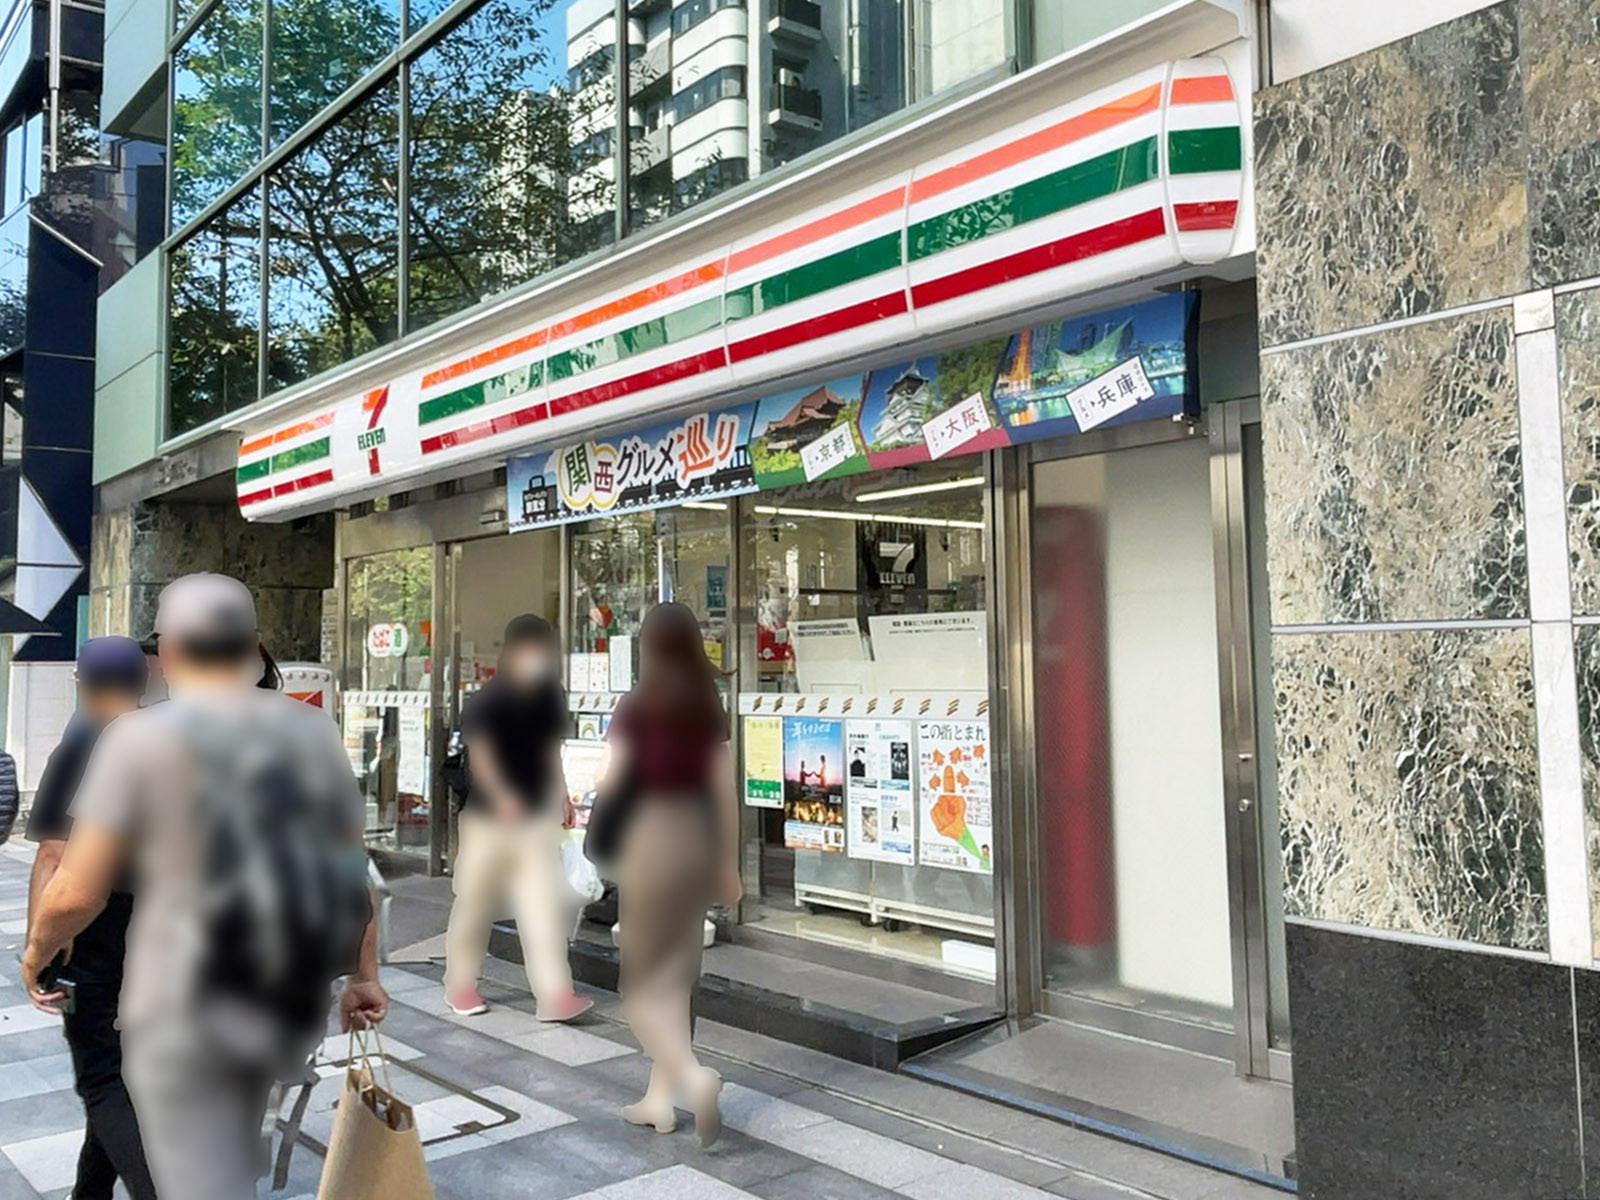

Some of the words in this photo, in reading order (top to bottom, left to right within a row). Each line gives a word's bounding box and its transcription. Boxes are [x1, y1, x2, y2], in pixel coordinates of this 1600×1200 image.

[1097, 372, 1138, 409] 兵庫
[362, 383, 390, 476] 7
[945, 406, 980, 439] 大阪
[565, 418, 735, 496] 関西グルメ巡り
[818, 434, 845, 462] 京都
[879, 541, 915, 590] 7
[920, 724, 986, 742] この指とまれ
